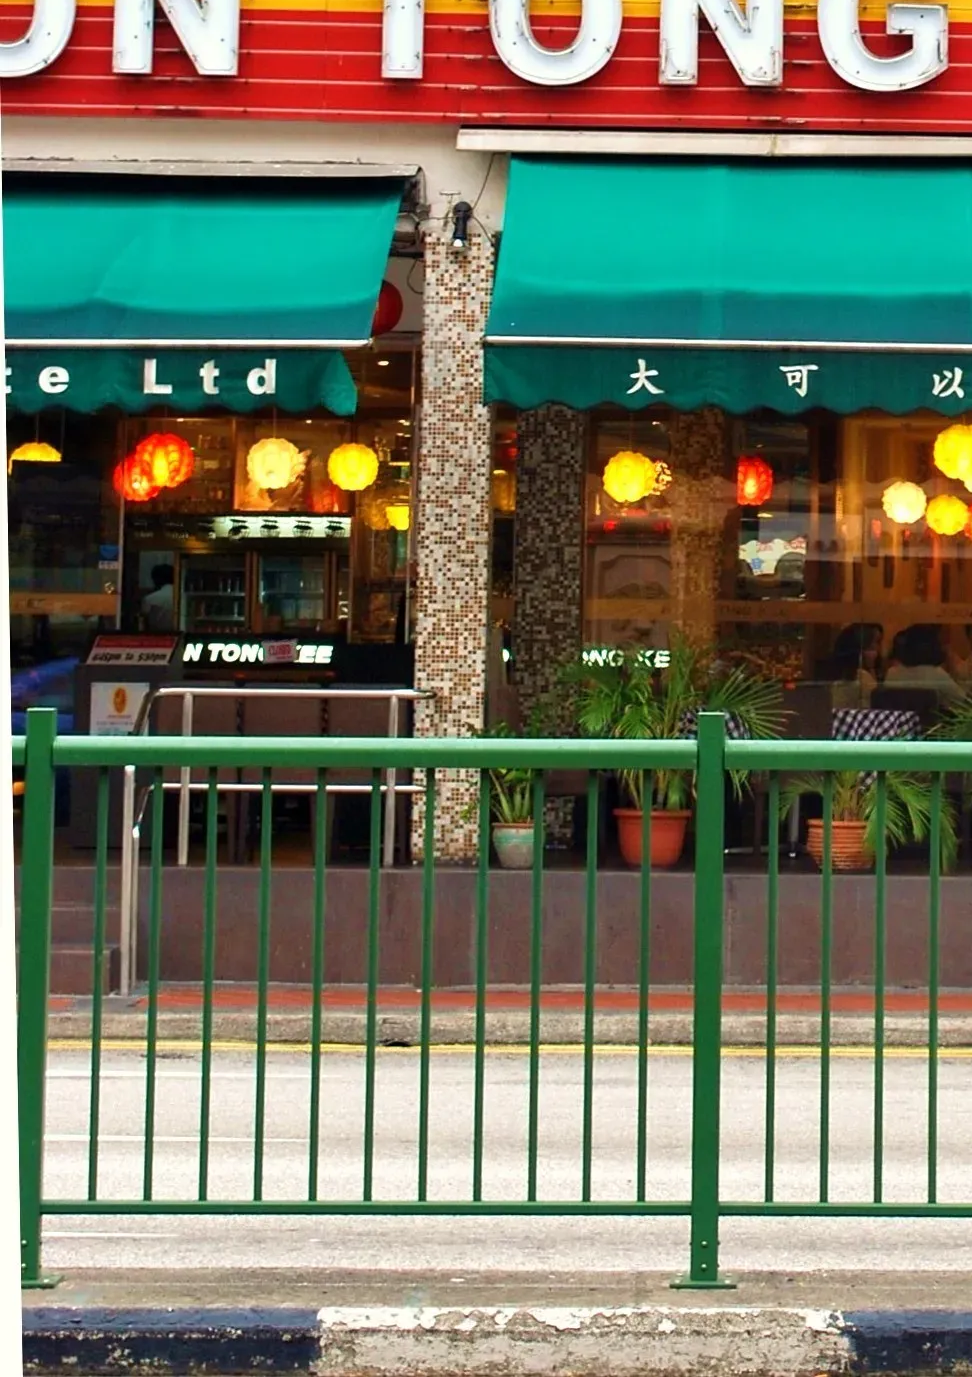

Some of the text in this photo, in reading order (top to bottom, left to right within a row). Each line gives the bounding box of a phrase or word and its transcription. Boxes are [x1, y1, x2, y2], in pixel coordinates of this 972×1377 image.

[143, 358, 277, 395] Ltd
[182, 643, 204, 662] N
[207, 643, 264, 663] TON
